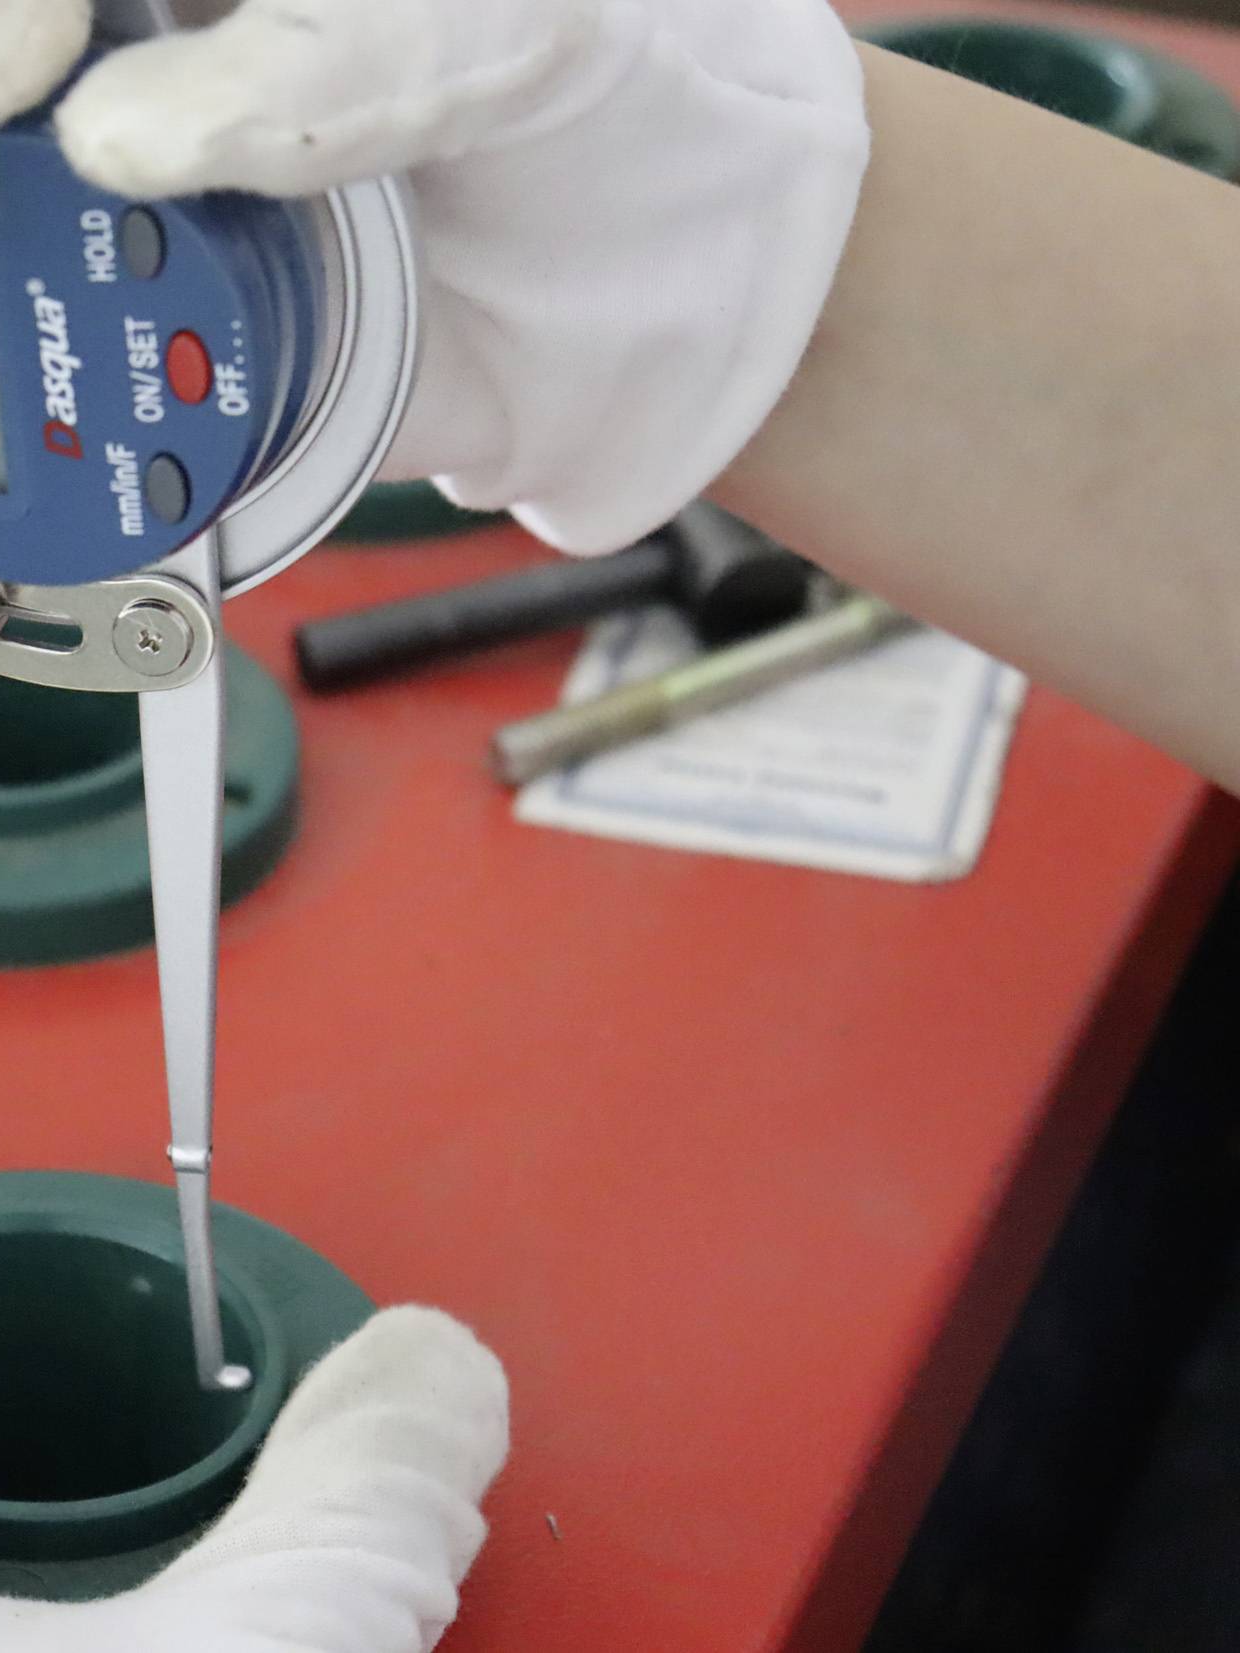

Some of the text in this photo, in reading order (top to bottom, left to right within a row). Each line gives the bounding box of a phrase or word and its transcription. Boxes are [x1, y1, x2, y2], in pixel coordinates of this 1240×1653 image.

[83, 210, 116, 282] HOLD
[127, 317, 164, 423] ON/SET
[107, 444, 144, 536] mm/in/F
